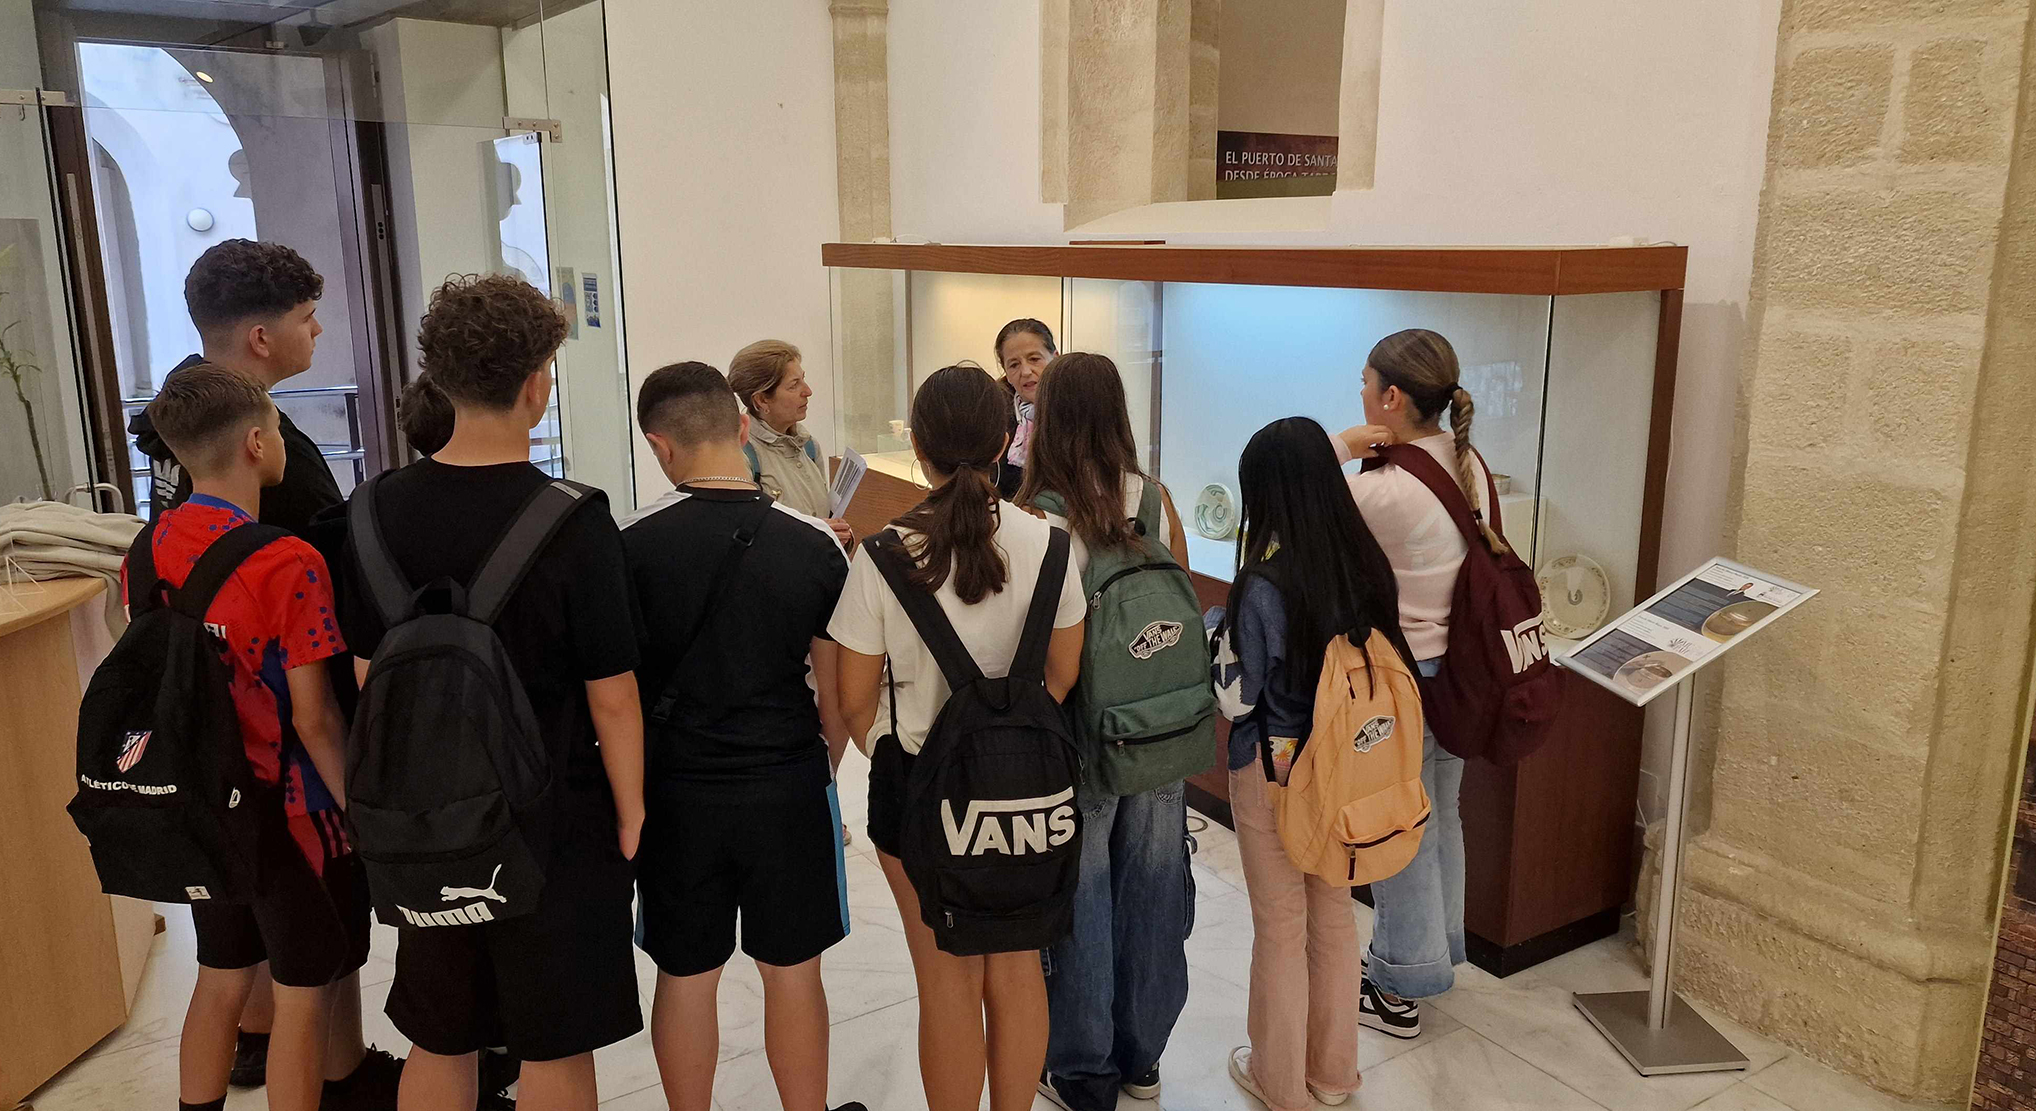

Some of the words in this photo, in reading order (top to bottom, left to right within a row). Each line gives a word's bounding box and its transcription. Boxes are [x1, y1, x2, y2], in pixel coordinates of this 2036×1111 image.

[1225, 150, 1239, 164] EL
[1241, 151, 1285, 166] PUERTO
[1287, 153, 1302, 166] DE
[1304, 154, 1338, 167] SANTA
[1142, 625, 1162, 641] VANS
[1147, 633, 1163, 649] THE
[137, 784, 178, 796] MADRID
[940, 786, 1076, 856] VANS
